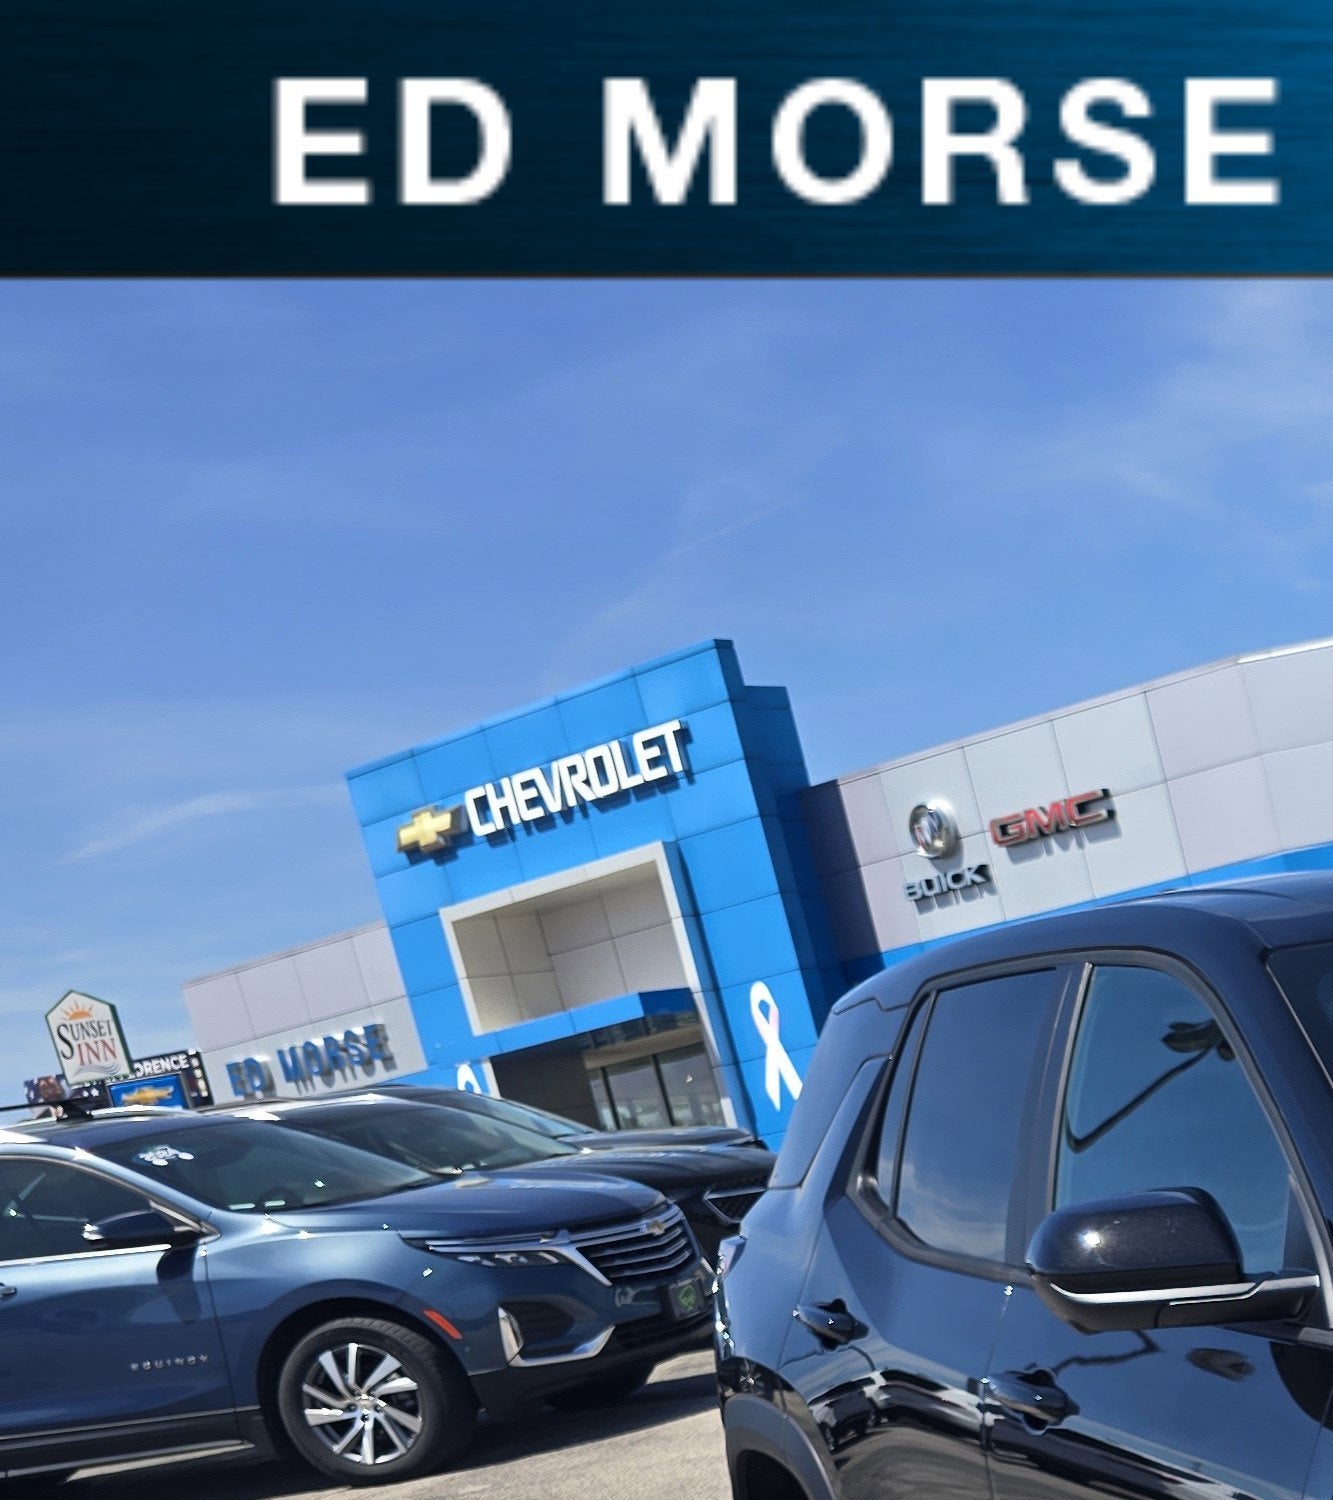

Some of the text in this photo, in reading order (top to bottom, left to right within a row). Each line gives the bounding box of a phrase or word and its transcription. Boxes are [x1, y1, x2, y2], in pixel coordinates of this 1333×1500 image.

[464, 718, 682, 837] CHEVROLET
[988, 788, 1112, 847] GMC
[904, 863, 990, 901] BUICK
[57, 1019, 113, 1060] SUNSET
[77, 1037, 118, 1067] INN
[125, 1053, 190, 1081] ORENCE
